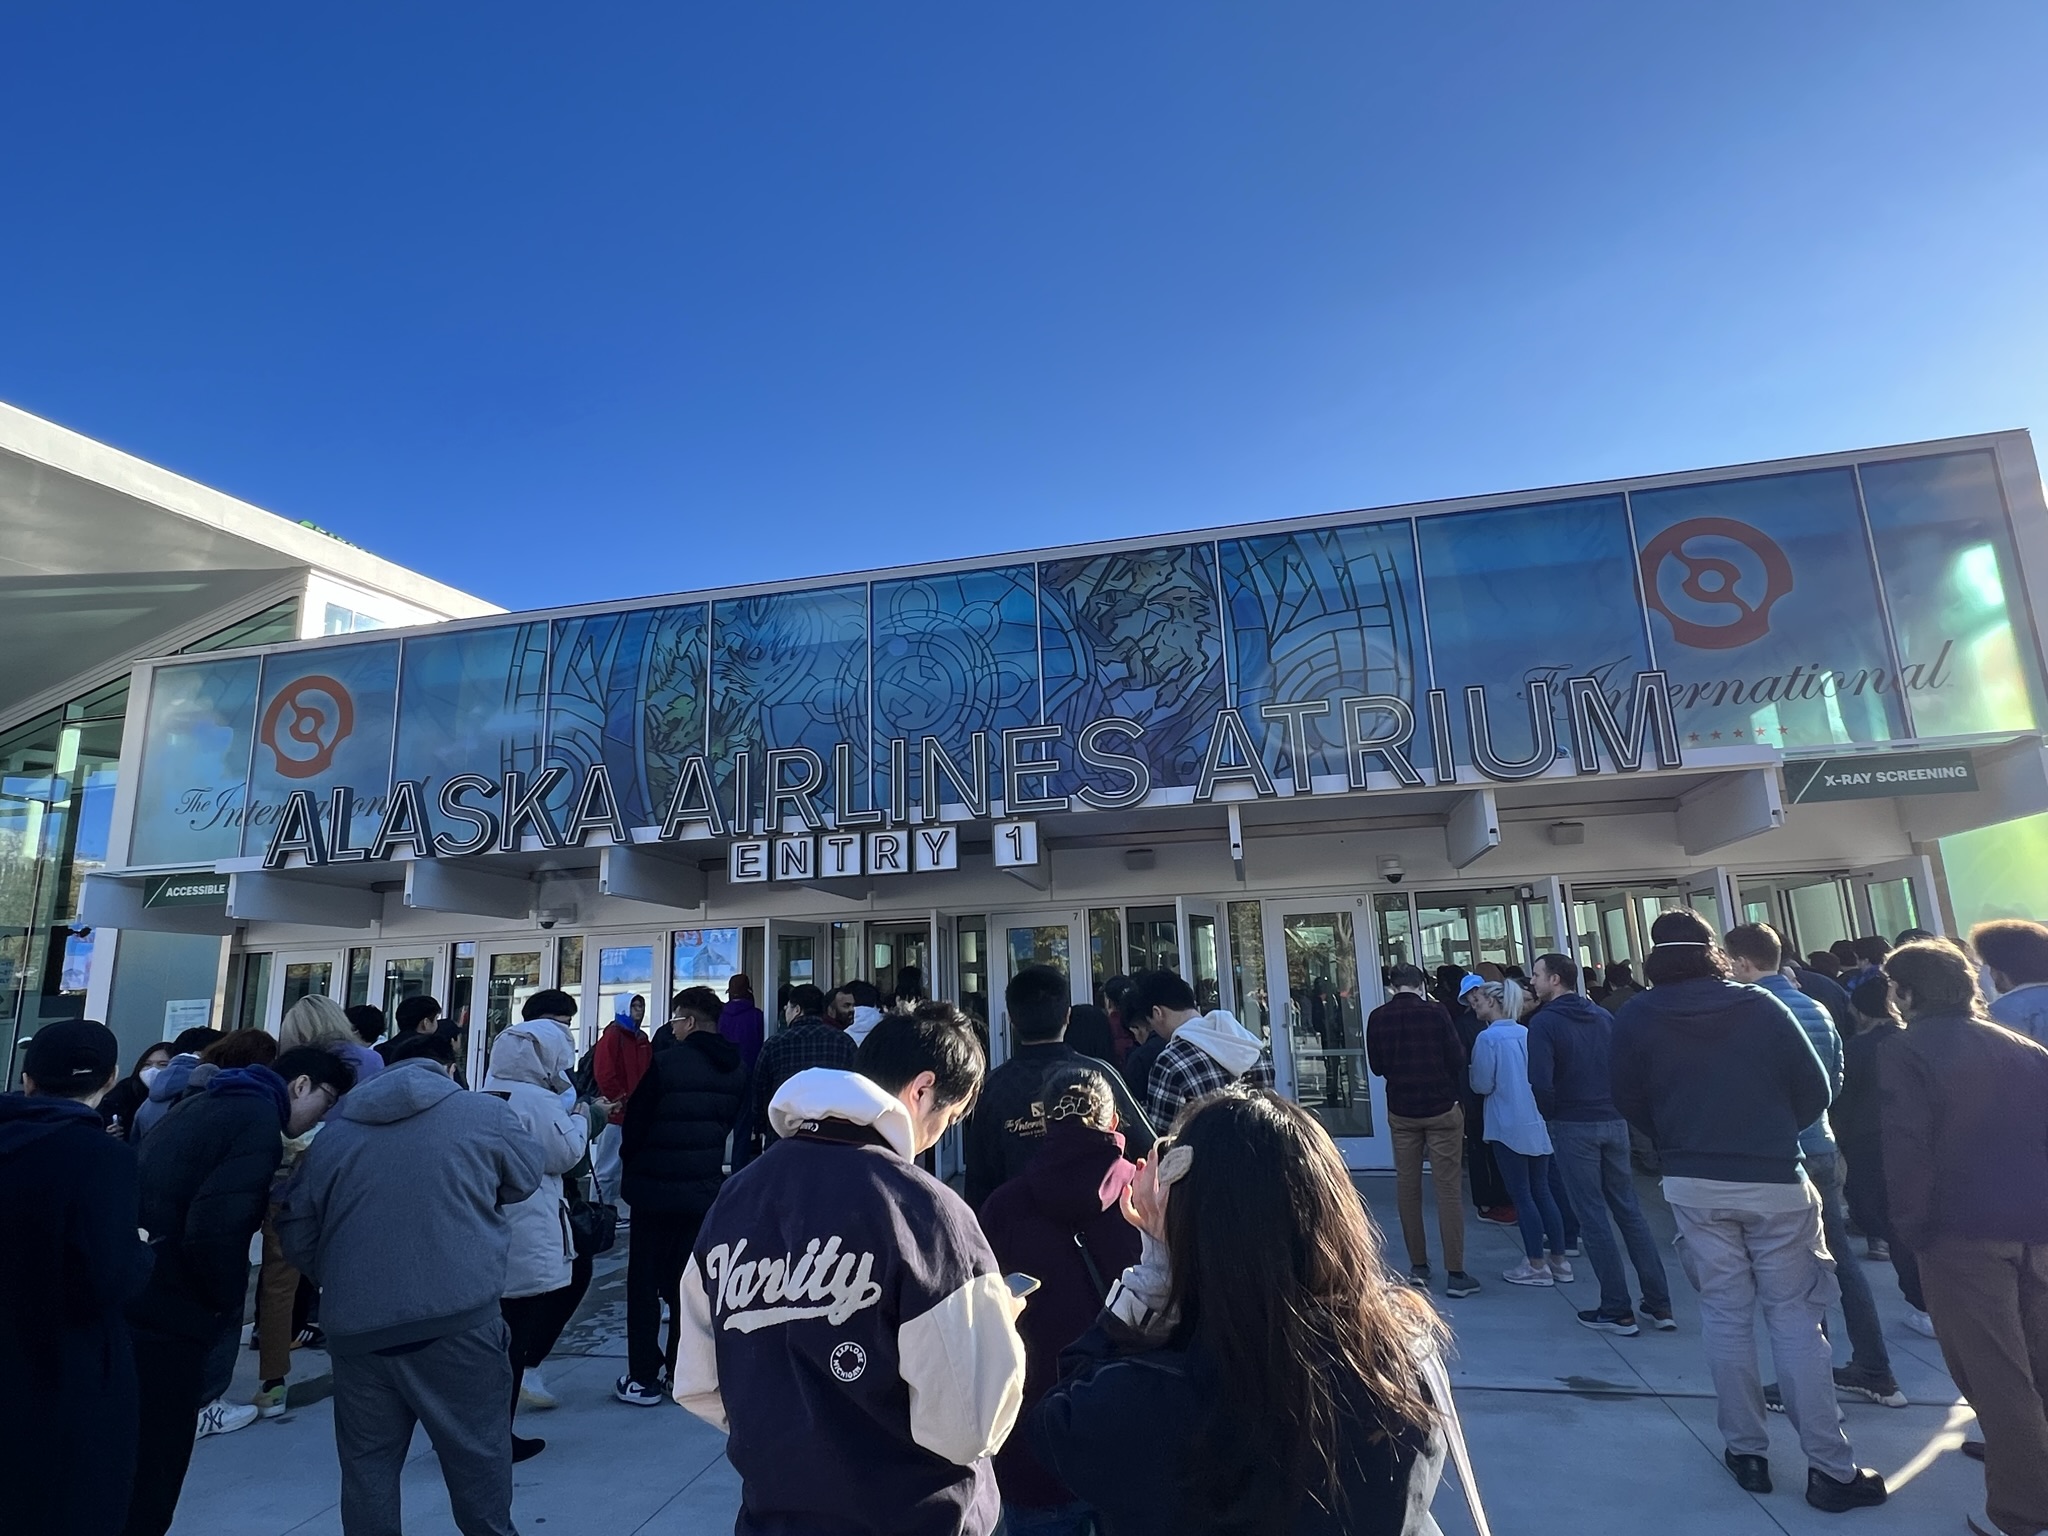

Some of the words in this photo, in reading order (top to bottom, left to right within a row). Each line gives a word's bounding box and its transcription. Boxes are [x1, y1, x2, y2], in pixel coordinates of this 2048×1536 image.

[262, 763, 628, 870] ALASKA
[659, 716, 1152, 841] AIRLINES
[1193, 669, 1684, 803] ATRIUM
[1824, 771, 1873, 787] X-RAY
[1876, 765, 1968, 783] SCREENING
[175, 786, 213, 816] The
[735, 830, 949, 878] ENTRY
[1005, 825, 1022, 862] 1
[165, 883, 226, 897] ACCESSIBLE
[1356, 898, 1363, 907] 9
[1073, 912, 1079, 921] 7
[706, 1235, 882, 1334] Varsity
[835, 1344, 864, 1364] EXPLORE
